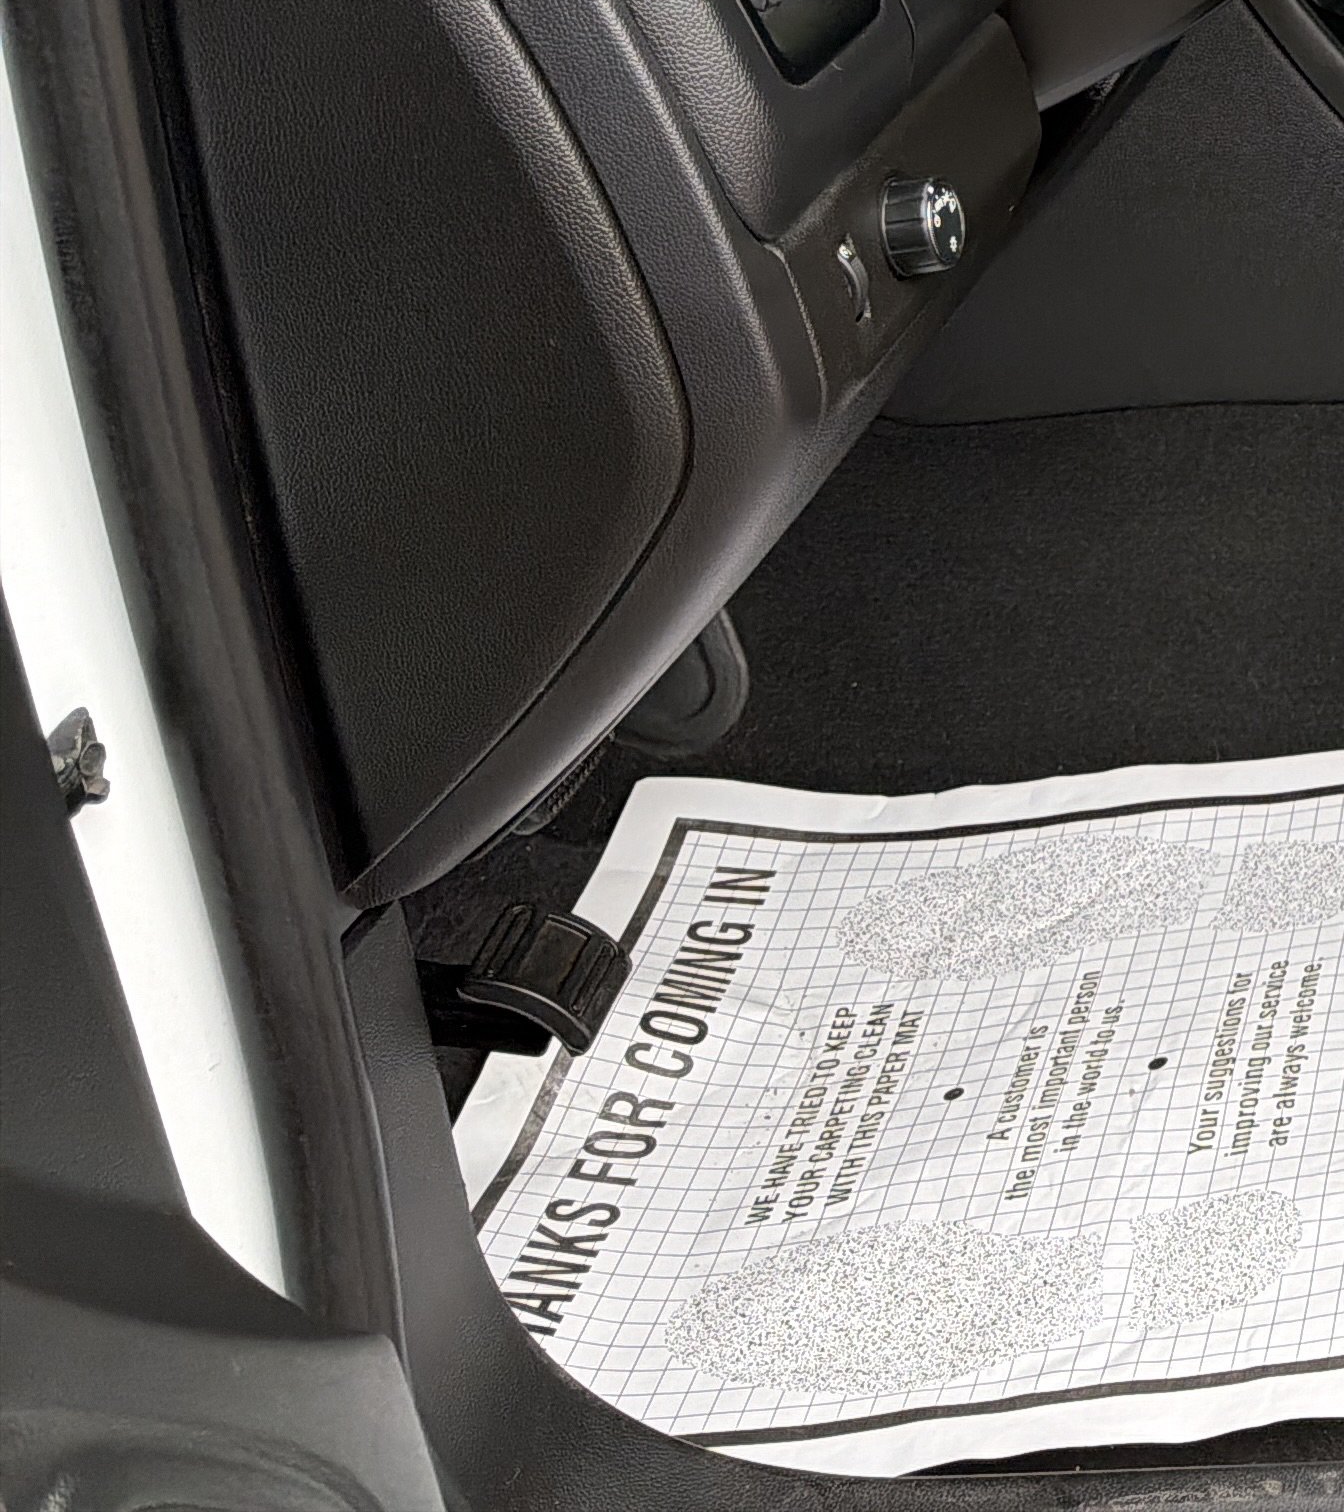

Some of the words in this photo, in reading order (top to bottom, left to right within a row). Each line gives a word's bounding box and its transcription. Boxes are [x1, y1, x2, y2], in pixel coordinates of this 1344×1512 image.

[1068, 970, 1100, 1025] person
[1101, 999, 1125, 1026] us.
[1260, 959, 1289, 1020] service
[567, 1091, 677, 1187] FOR
[625, 919, 756, 1079] COMING
[703, 866, 777, 905] IN
[823, 1007, 857, 1056] KEEP
[1021, 1025, 1048, 1043] is
[1097, 1028, 1116, 1046] to
[1252, 1025, 1274, 1052] our
[813, 1058, 840, 1085] TO
[998, 1045, 1041, 1123] customer
[1033, 1029, 1081, 1111] important
[1078, 1047, 1108, 1096] world
[1187, 1108, 1219, 1156] Your
[1204, 997, 1247, 1102] suggestions
[1227, 972, 1253, 995] for
[1273, 1043, 1308, 1110] always
[782, 1166, 827, 1224] YOUR
[809, 1064, 870, 1165] CARPETING
[854, 1003, 895, 1061] CLEAN
[785, 1087, 828, 1139] TRIED
[824, 1157, 866, 1207] WITH
[848, 1111, 884, 1155] THIS
[868, 1050, 910, 1108] PAPER
[892, 1008, 925, 1047] MAT
[1063, 1099, 1092, 1131] the
[1224, 1056, 1272, 1157] improving
[987, 1127, 1012, 1141] A
[1021, 1114, 1052, 1162] most
[1054, 1133, 1081, 1153] in
[1269, 1116, 1292, 1147] are
[761, 1142, 804, 1190] HAVE
[1005, 1169, 1035, 1201] the
[744, 1192, 780, 1225] WE
